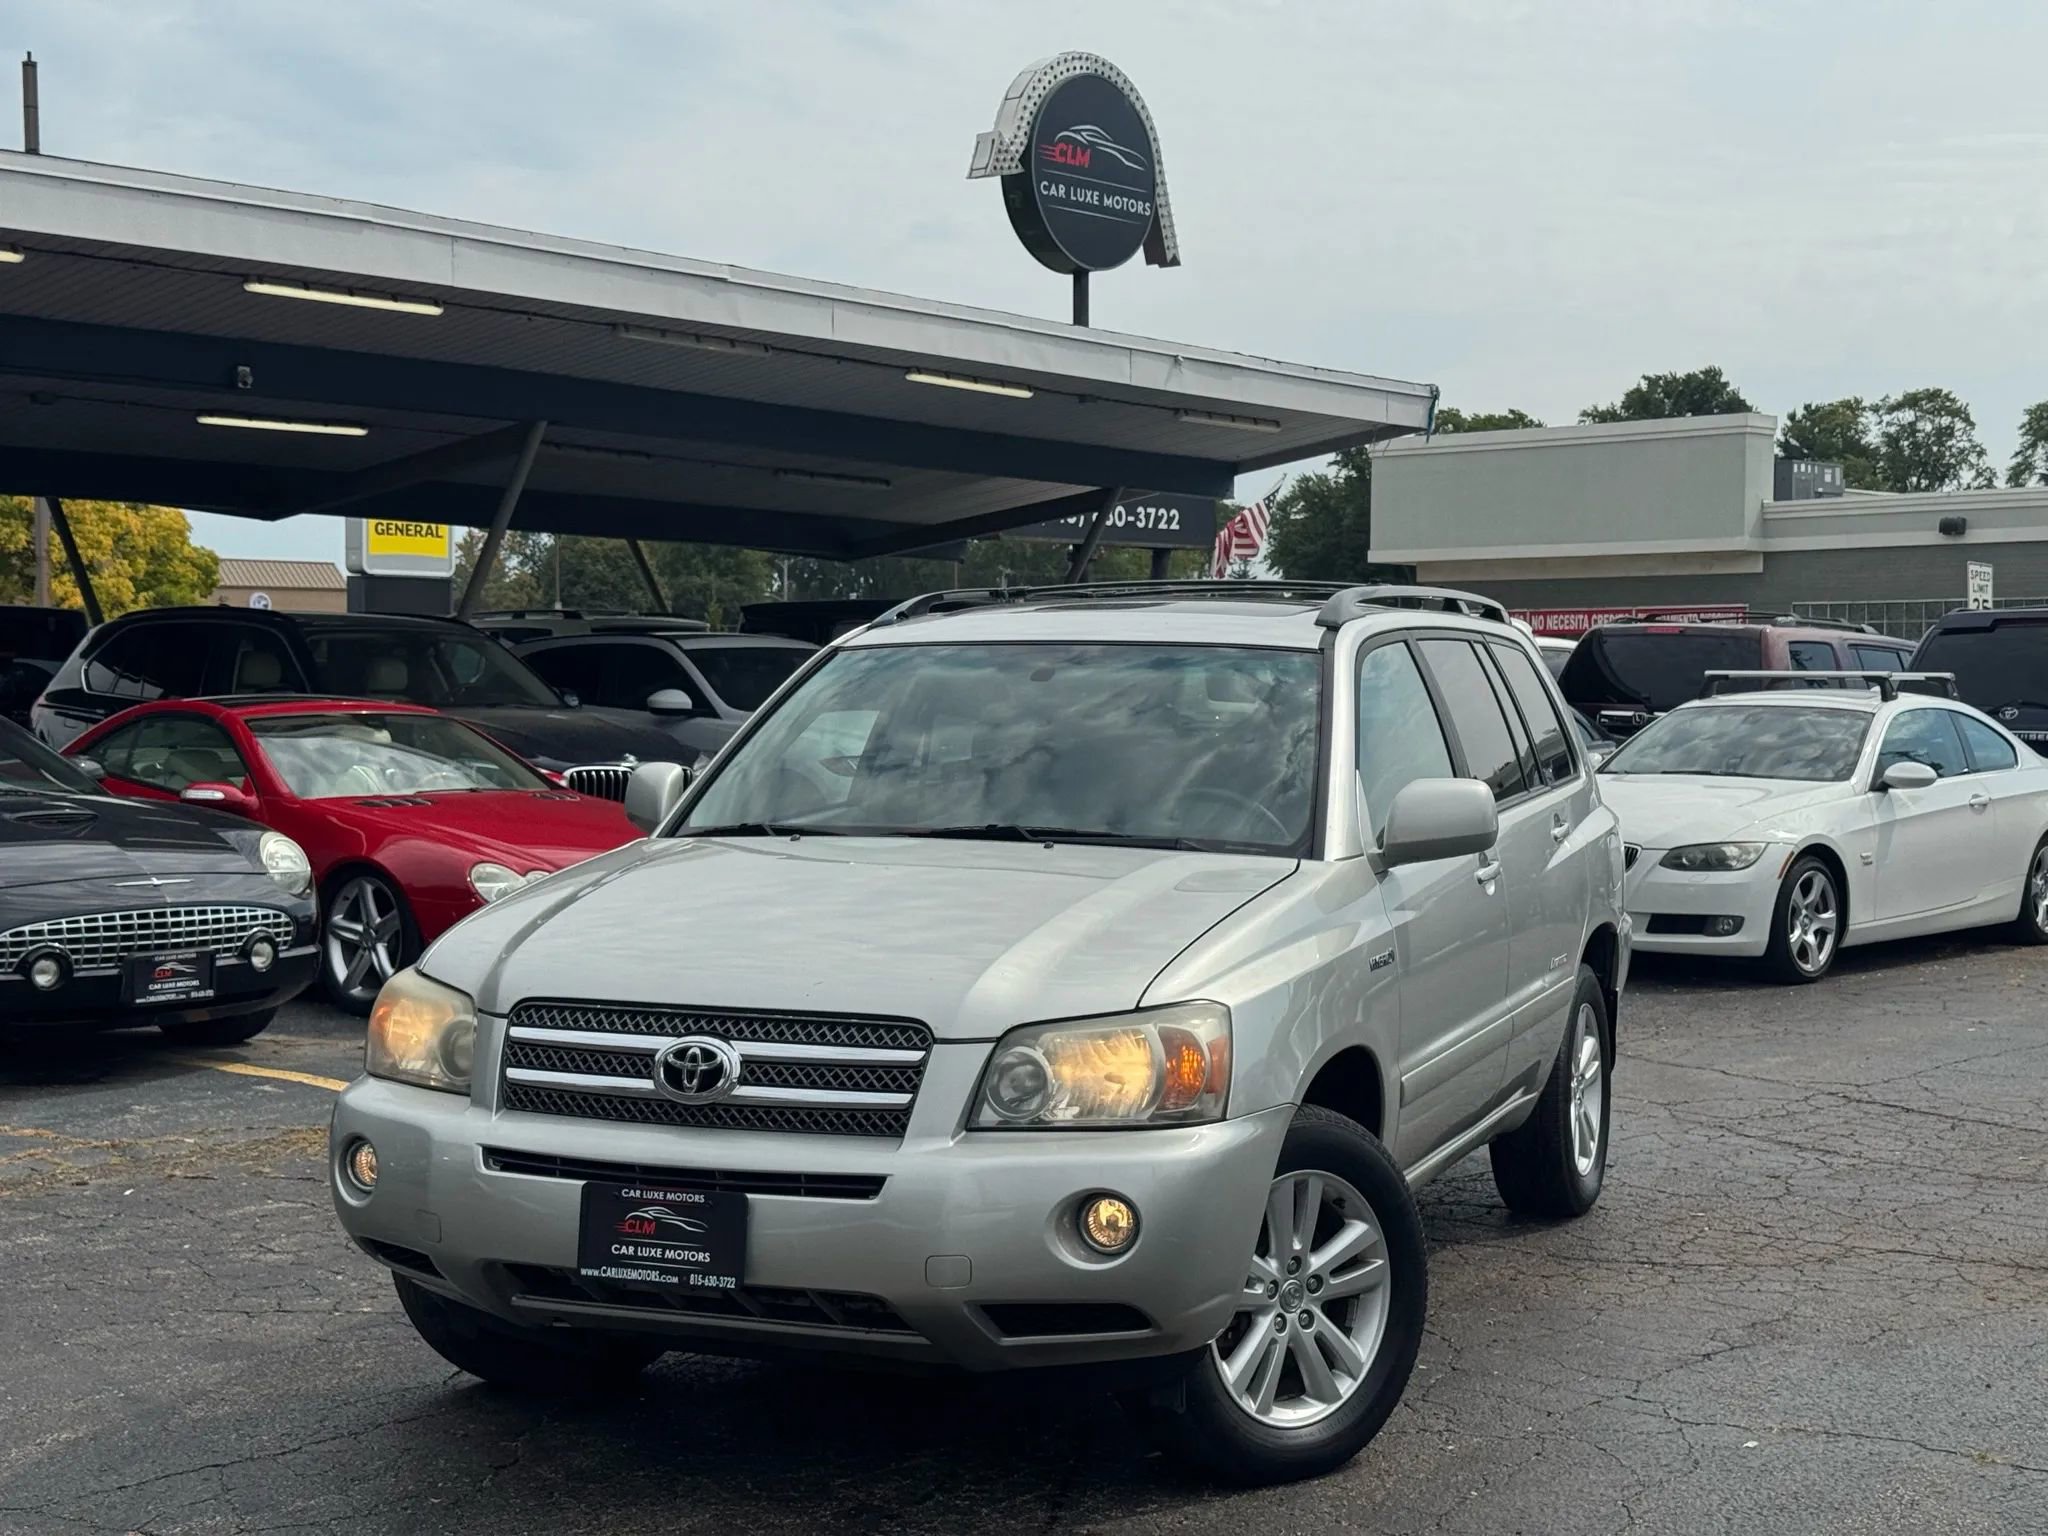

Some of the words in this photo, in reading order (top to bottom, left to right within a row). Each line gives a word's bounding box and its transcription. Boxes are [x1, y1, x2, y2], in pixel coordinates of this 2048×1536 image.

[1054, 143, 1091, 168] CLM
[1040, 181, 1066, 199] CAR
[1070, 187, 1100, 205] LUXE
[1103, 193, 1151, 216] MOTORS
[374, 522, 444, 539] GENERAL
[1970, 569, 1991, 582] SPEED
[1972, 583, 1989, 594] LIMIT
[1531, 615, 1544, 631] NO
[1546, 613, 1590, 631] NECESITA
[621, 1188, 641, 1198] CAR
[643, 1190, 664, 1200] LUXE
[665, 1192, 705, 1203] MOTORS
[624, 1219, 656, 1235] CLM
[611, 1244, 635, 1255] CAR
[637, 1246, 662, 1258] LUXE
[664, 1250, 711, 1263] MOTORS
[689, 1274, 736, 1289] 815-630-3722
